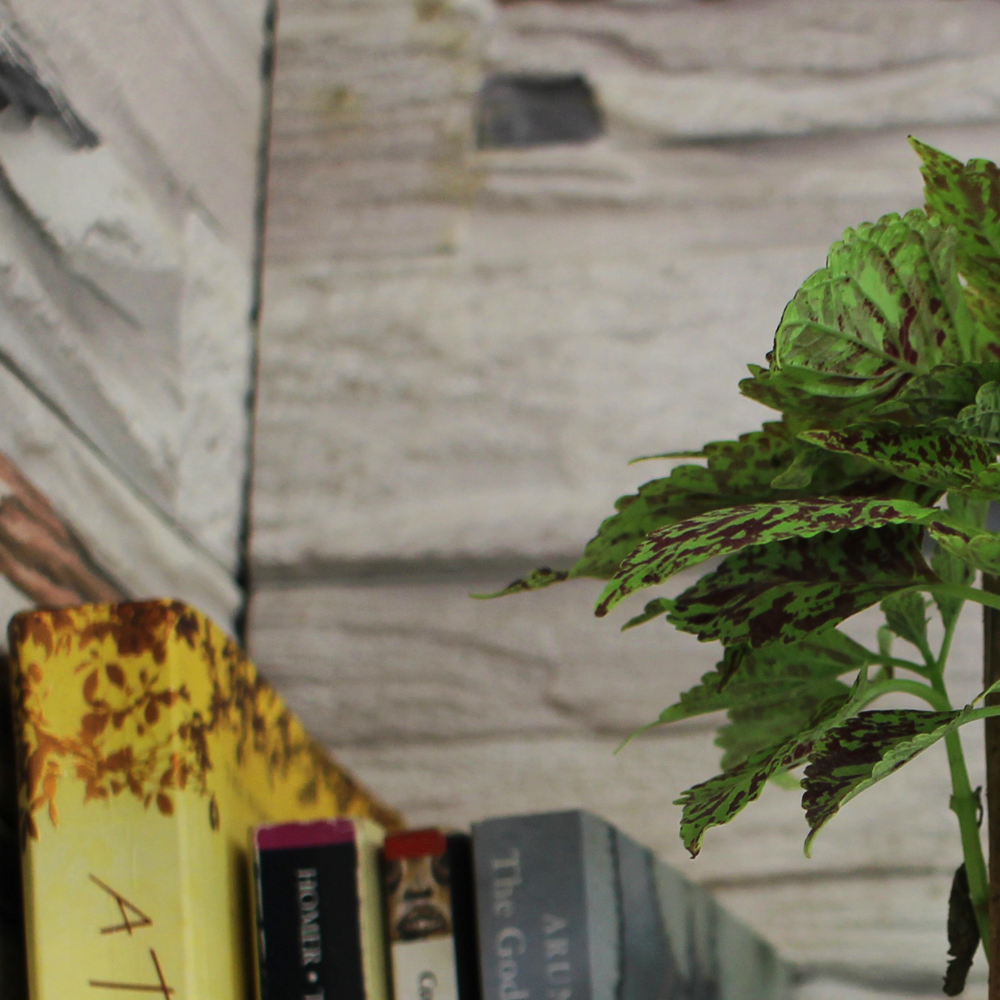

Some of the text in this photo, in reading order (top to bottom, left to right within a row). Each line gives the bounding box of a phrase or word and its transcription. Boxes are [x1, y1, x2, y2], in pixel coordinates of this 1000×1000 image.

[89, 872, 153, 936] A
[297, 867, 323, 967] HOMER
[491, 846, 524, 920] The
